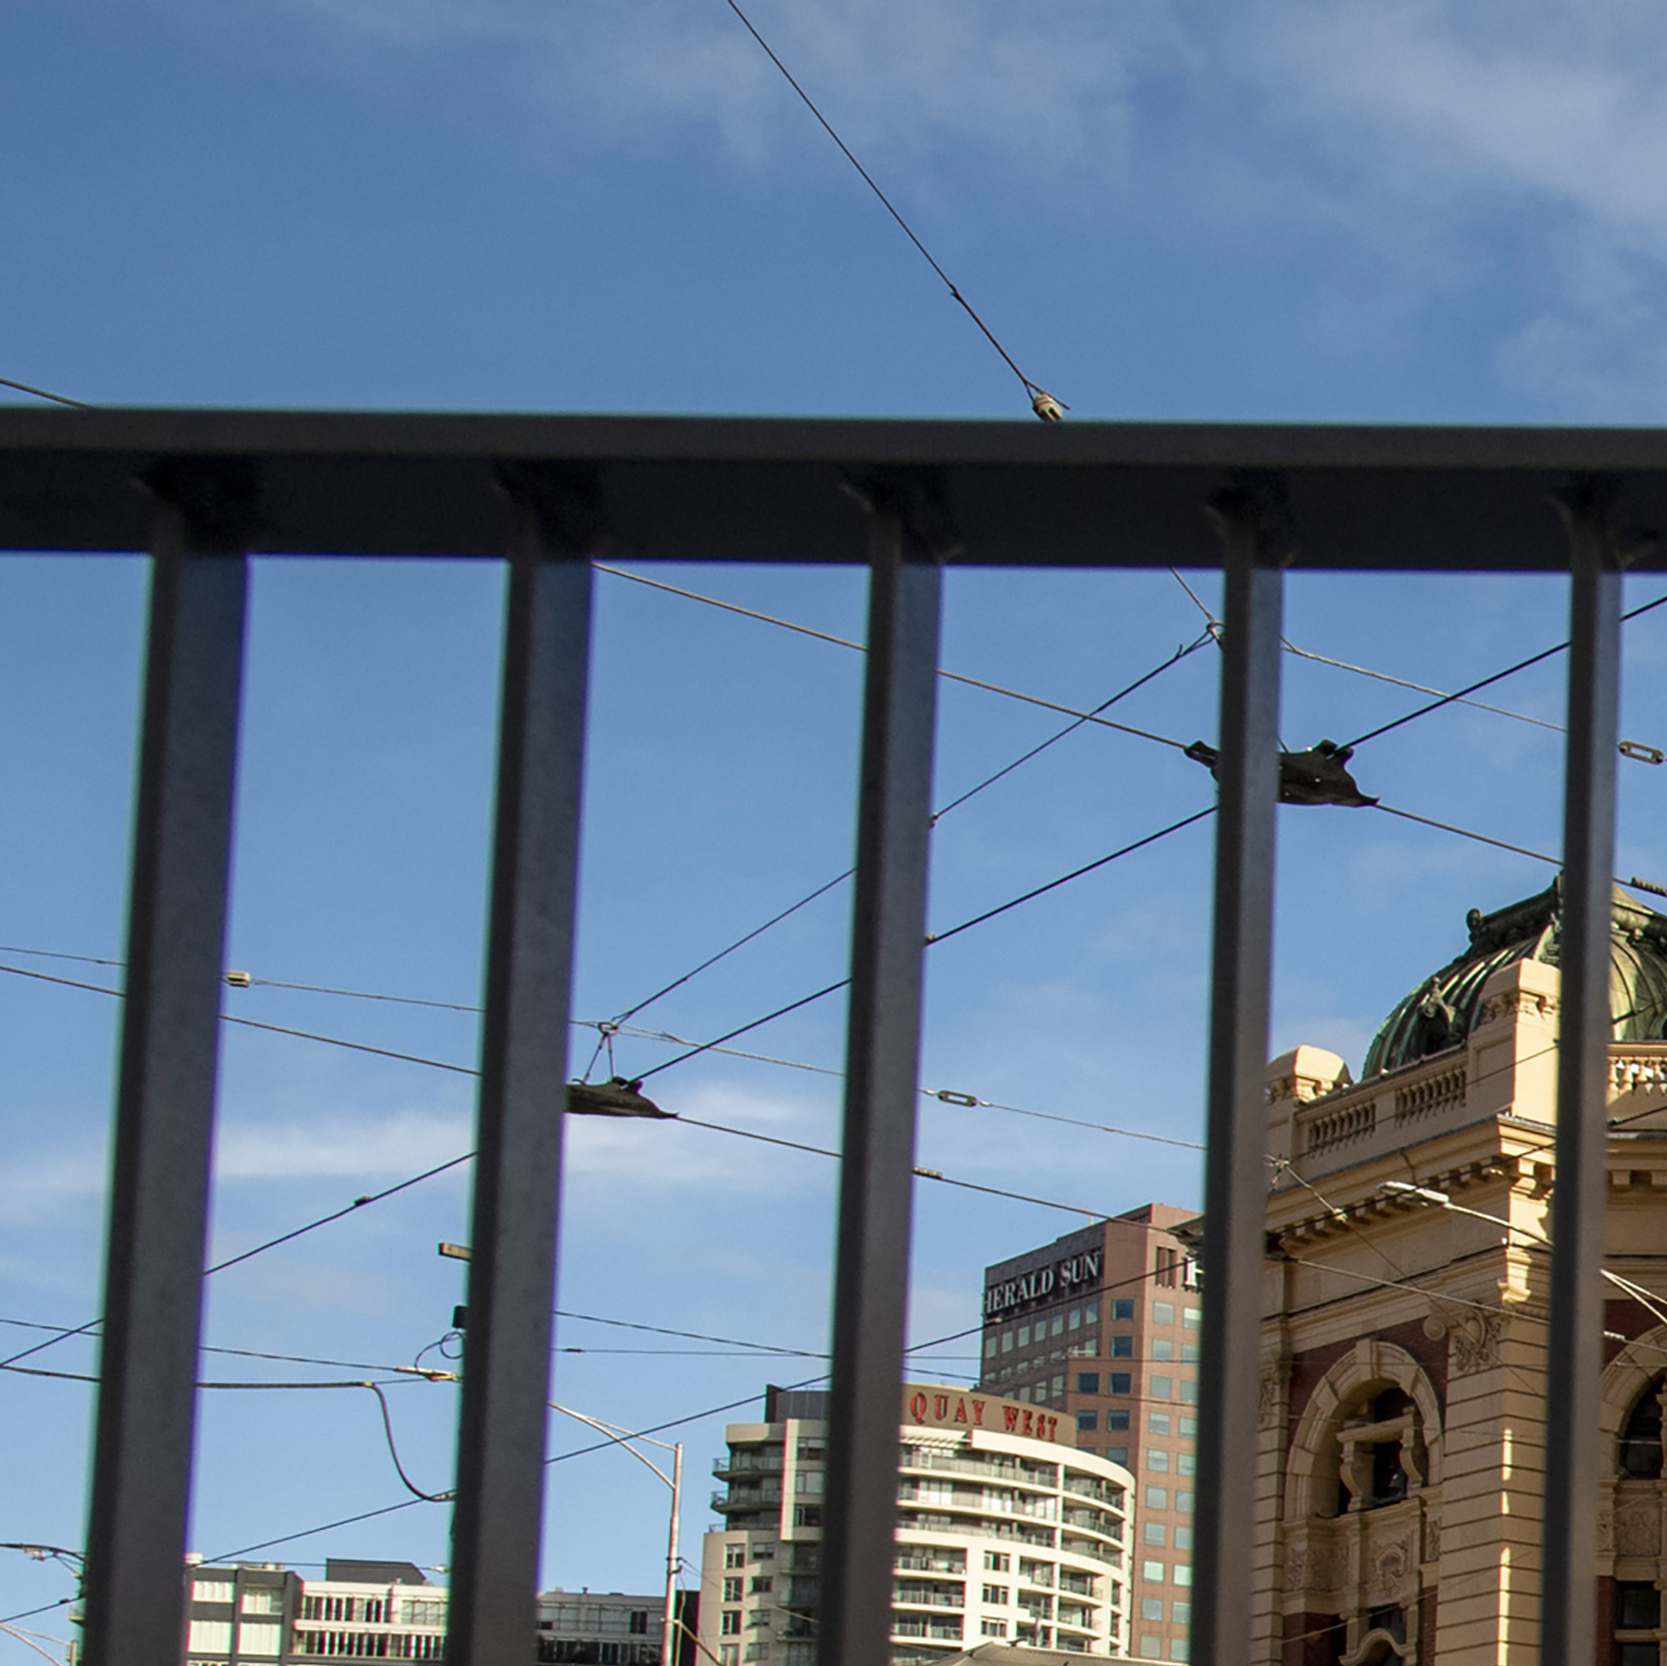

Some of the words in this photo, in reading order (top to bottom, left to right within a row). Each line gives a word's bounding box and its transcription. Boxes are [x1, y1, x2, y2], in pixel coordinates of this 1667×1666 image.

[985, 1270, 1054, 1314] HERALD
[1060, 1252, 1101, 1287] SUN
[910, 1392, 986, 1425] QUAY
[1002, 1405, 1058, 1442] WEST
